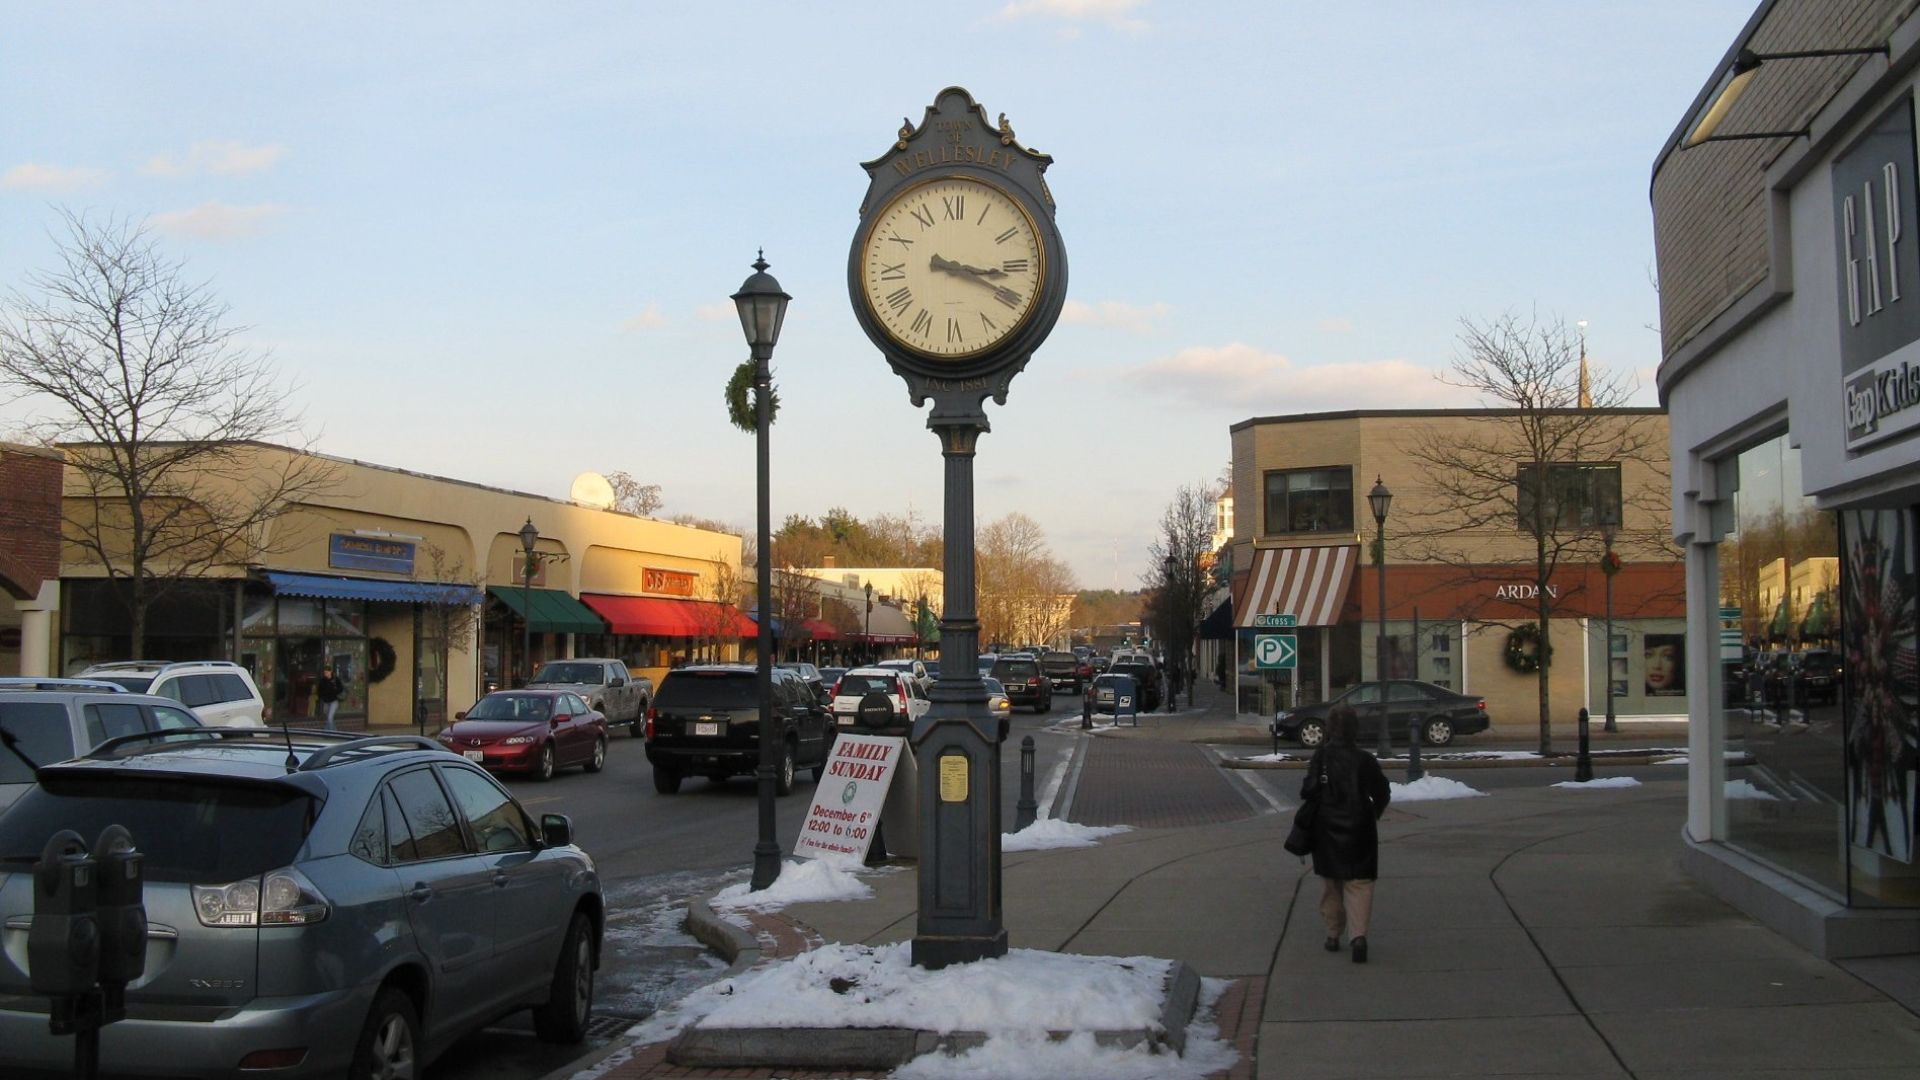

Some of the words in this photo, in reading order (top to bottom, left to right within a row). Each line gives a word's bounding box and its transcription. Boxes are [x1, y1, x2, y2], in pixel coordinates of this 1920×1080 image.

[893, 144, 1017, 177] WELLESLEY
[942, 195, 965, 220] XII
[888, 230, 914, 251] X
[1844, 161, 1901, 327] GAP
[1003, 259, 1028, 272] III
[947, 317, 963, 343] VI
[960, 376, 987, 392] 1881
[1496, 584, 1558, 599] ARDAN
[1267, 616, 1288, 625] Cross
[1263, 641, 1277, 661] P
[836, 741, 893, 761] FAMILY
[828, 760, 888, 781] SUNDAY
[813, 804, 857, 822] December
[808, 819, 831, 833] 12:00
[833, 824, 842, 836] to
[845, 825, 867, 840] 6:00
